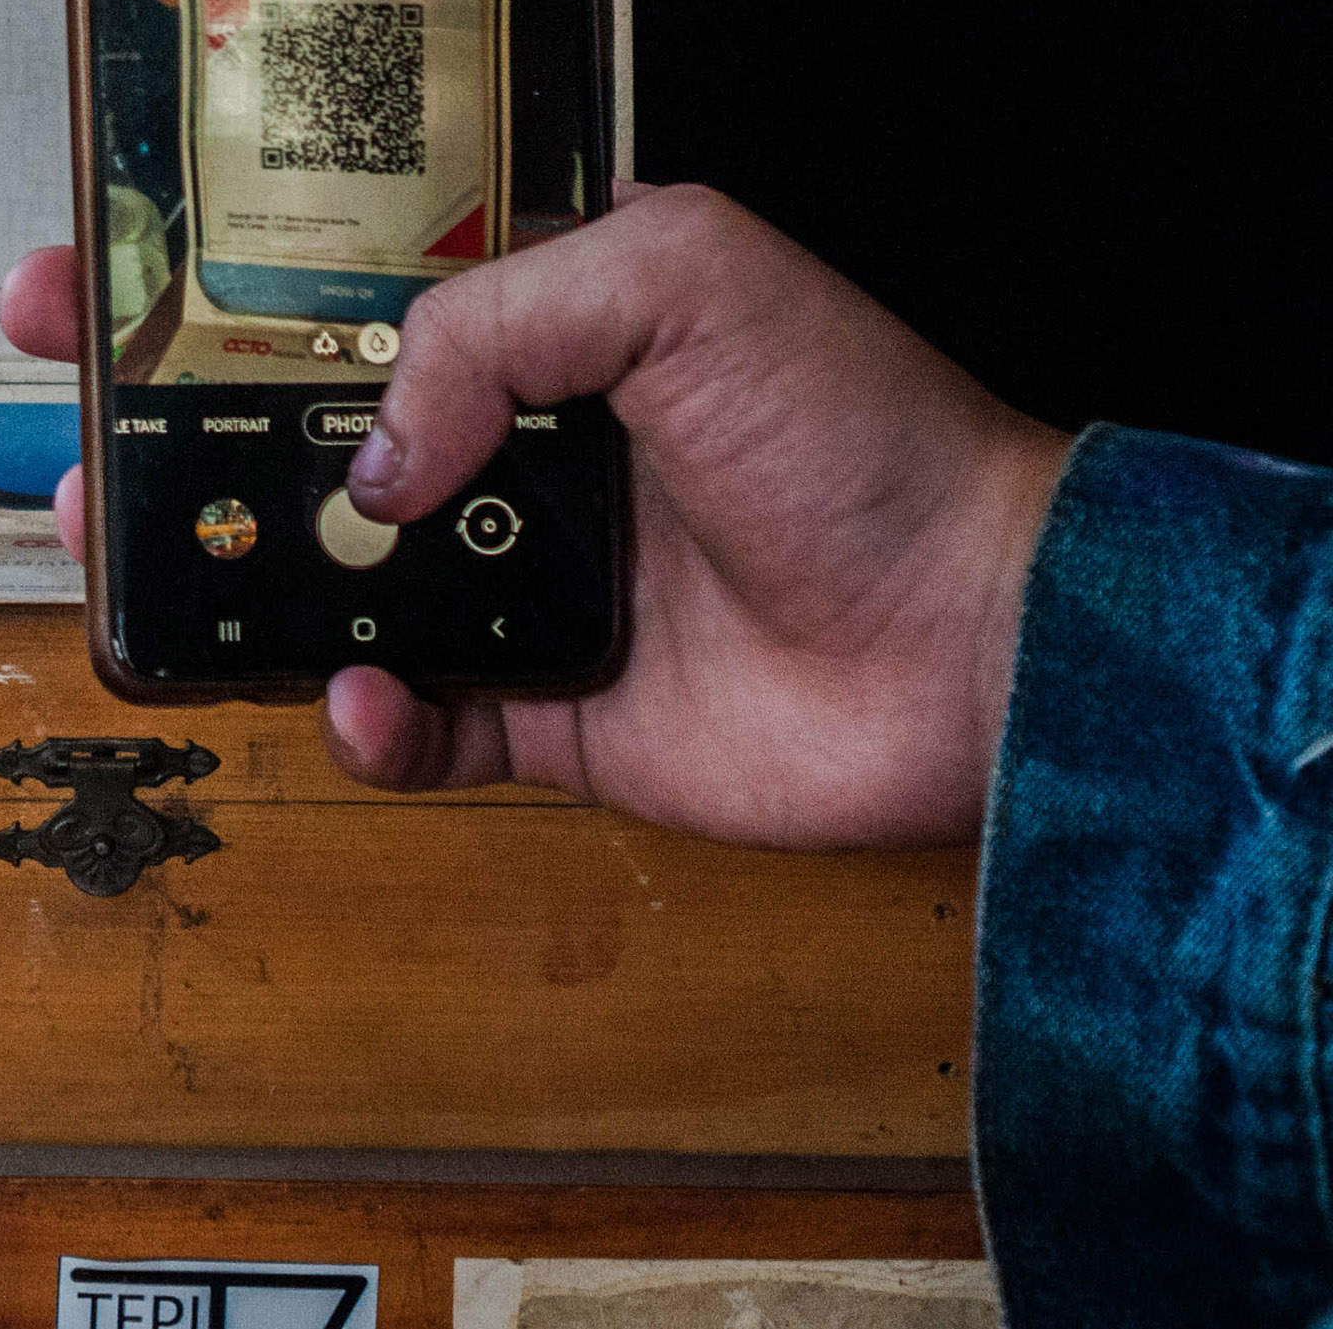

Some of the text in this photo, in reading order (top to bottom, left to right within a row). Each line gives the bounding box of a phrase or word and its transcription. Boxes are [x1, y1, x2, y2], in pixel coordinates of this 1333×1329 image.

[132, 419, 168, 433] TAKE
[202, 417, 270, 433] PORTRAIT
[323, 415, 374, 433] PHOT
[515, 415, 558, 430] MORE
